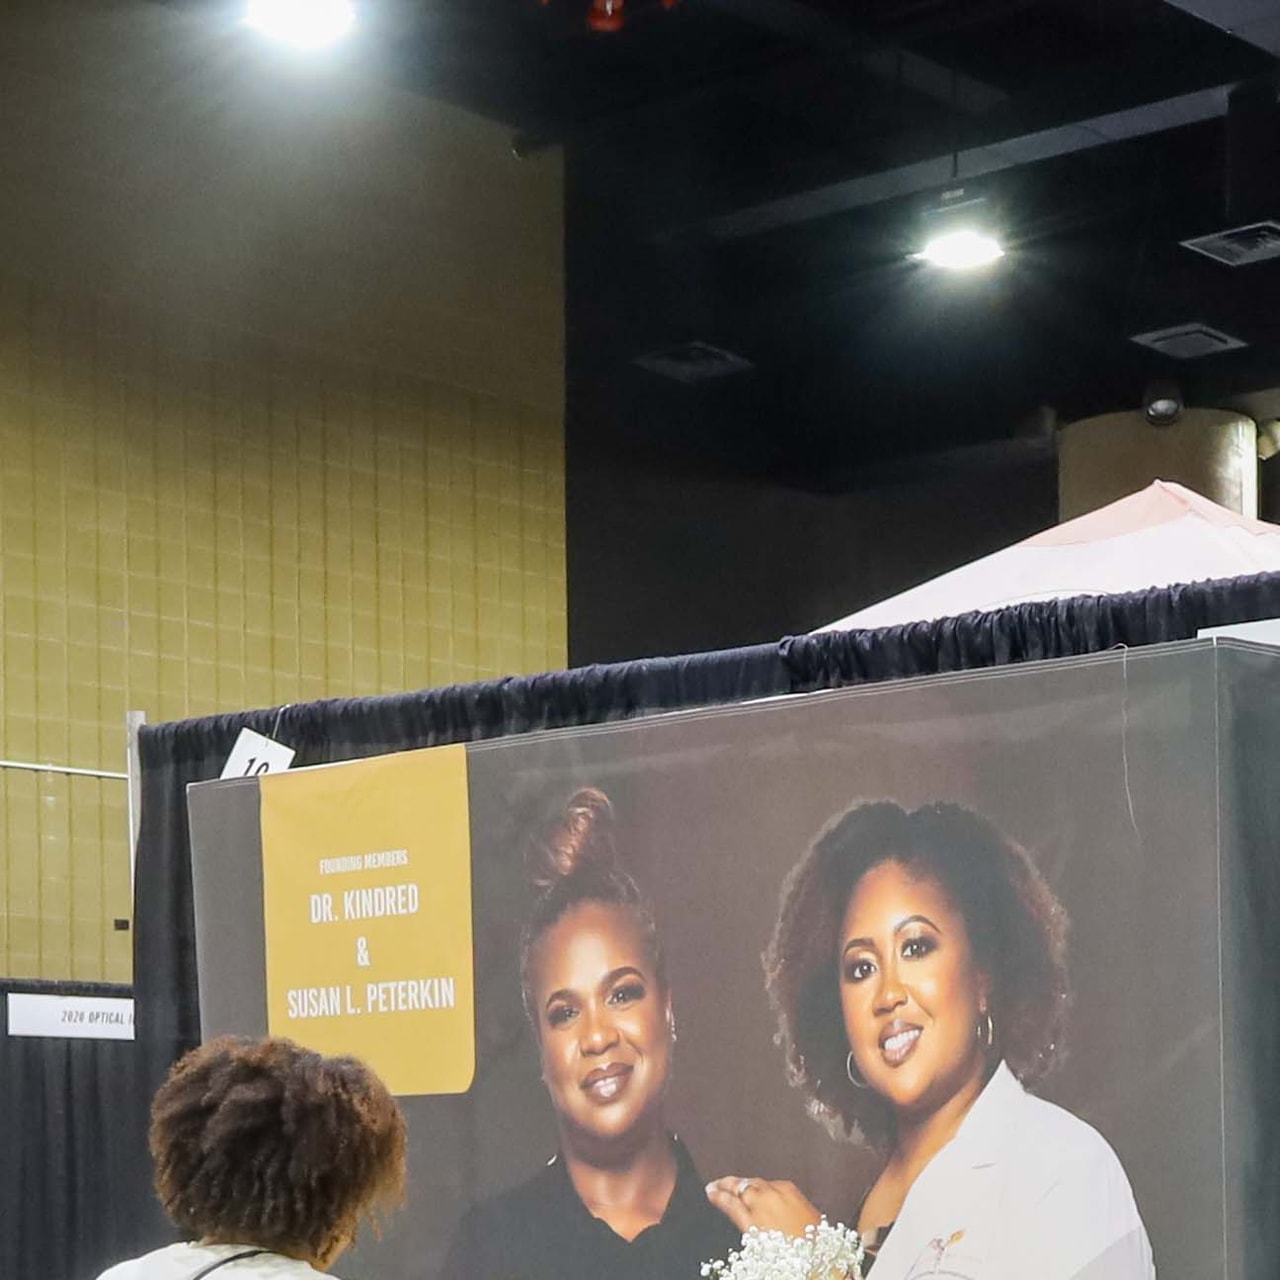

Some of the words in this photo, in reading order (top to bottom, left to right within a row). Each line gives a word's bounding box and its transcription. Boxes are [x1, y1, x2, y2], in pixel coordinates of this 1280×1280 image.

[364, 849, 409, 870] MEMBERS
[310, 892, 339, 924] DR.
[344, 884, 419, 921] KINDRED
[356, 935, 370, 967] &
[287, 986, 341, 1019] SUSAN
[346, 985, 362, 1015] L.
[367, 977, 455, 1013] PETERKIN
[88, 1011, 125, 1025] OPTICAL
